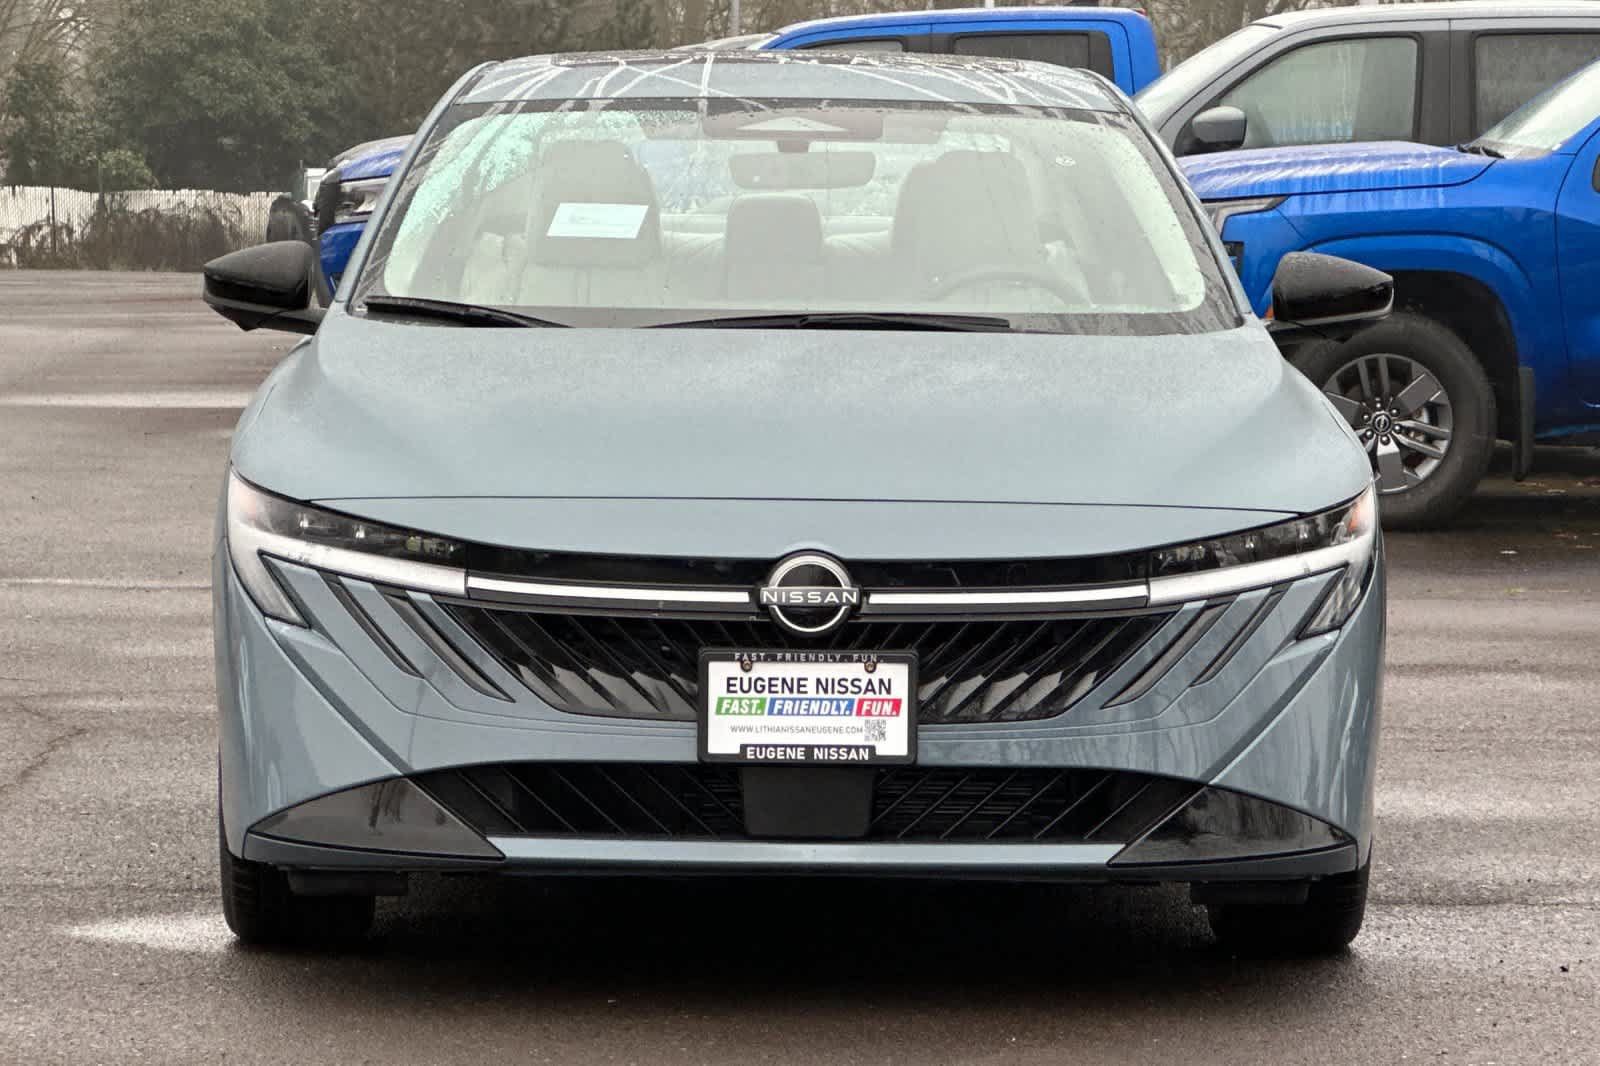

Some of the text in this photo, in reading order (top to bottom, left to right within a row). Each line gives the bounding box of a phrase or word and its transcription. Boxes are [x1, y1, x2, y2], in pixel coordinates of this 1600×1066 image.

[763, 591, 857, 603] NISSAN
[726, 677, 892, 695] EUGENE NISSAN
[720, 699, 897, 716] FAST. FRIENDLY. FUN.
[730, 725, 863, 734] WWW.LITHIANISSANEUGENE.COM
[746, 747, 869, 760] EUGENE NISSAN
